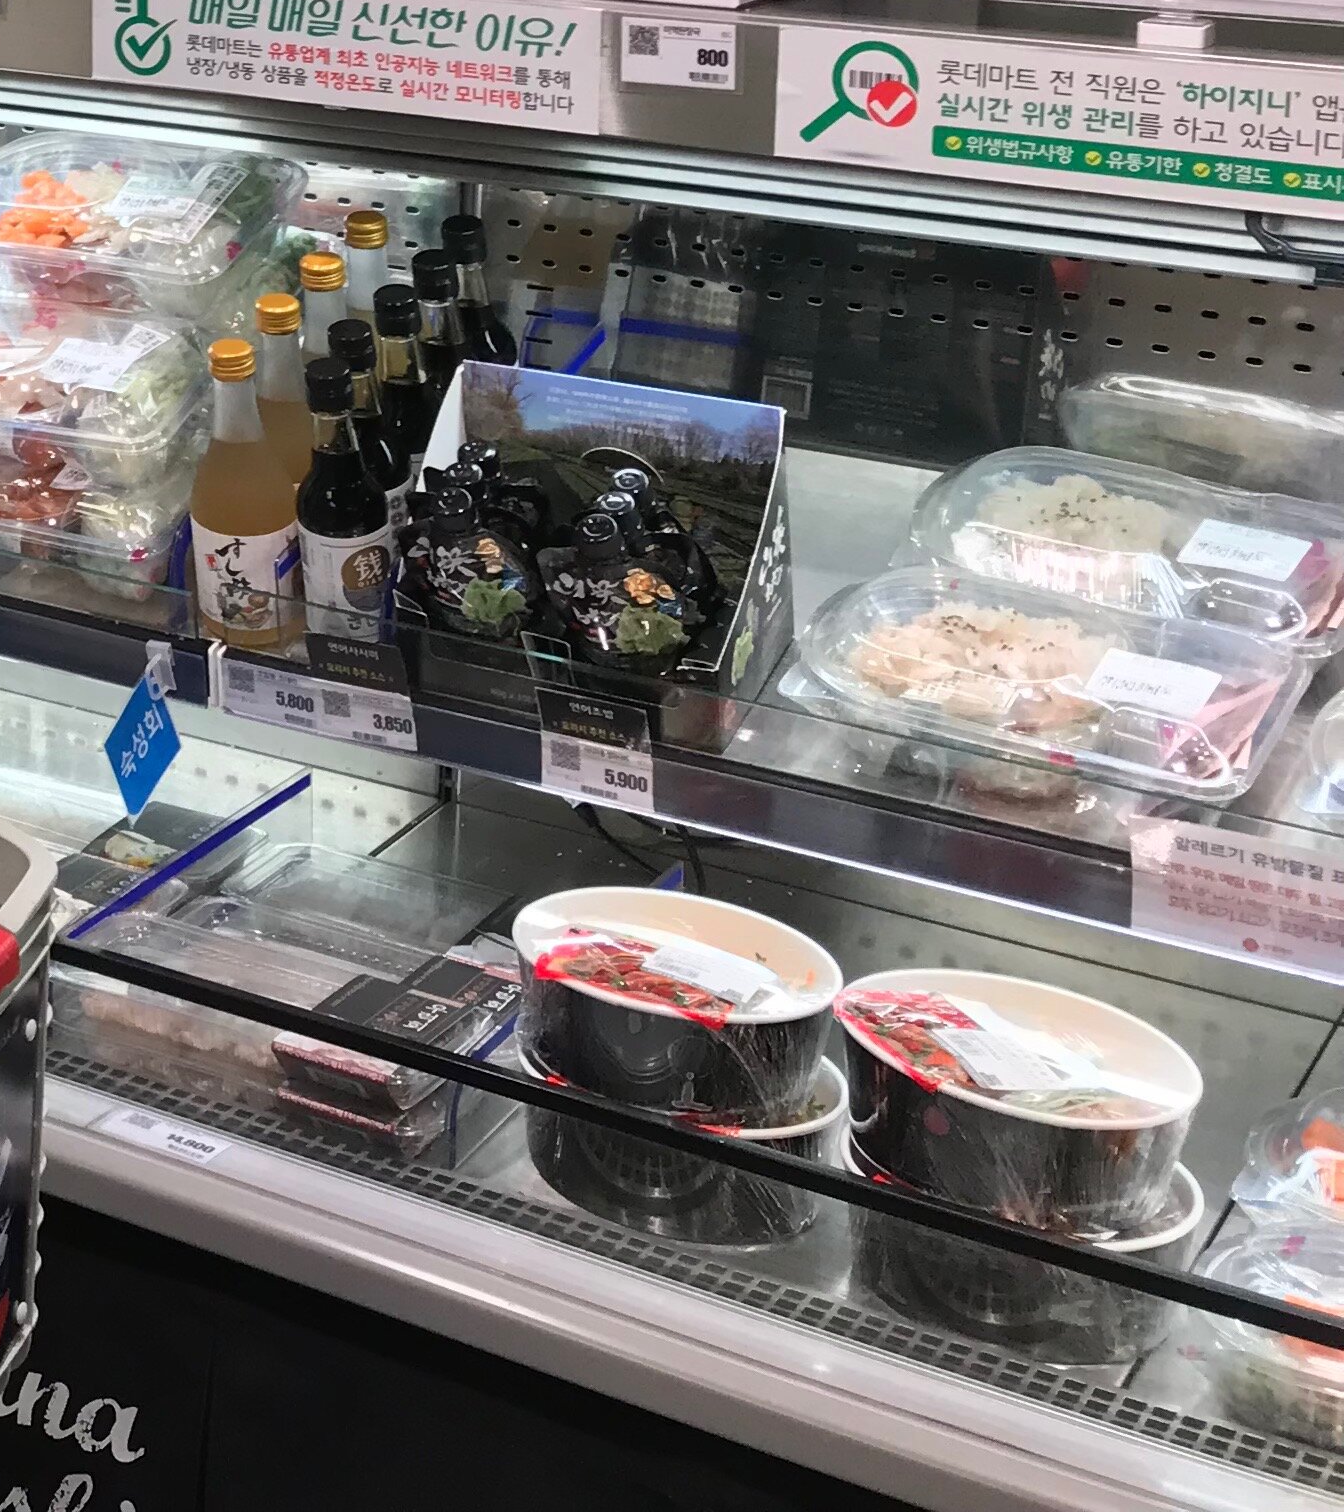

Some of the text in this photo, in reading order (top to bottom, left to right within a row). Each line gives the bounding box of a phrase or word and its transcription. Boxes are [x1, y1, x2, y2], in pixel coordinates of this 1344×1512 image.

[352, 0, 468, 48] 신선한
[477, 10, 576, 59] 이유!
[185, 33, 572, 90] 롯데마트는 유통업계 최초 인공지능 네트워크를 통해
[697, 48, 729, 67] 800
[937, 59, 1039, 93] 롯데마트
[1049, 67, 1075, 96] 전
[1085, 72, 1166, 105] 직원은
[185, 55, 574, 116] 냉장/냉동 상품을 적정온도로 실시간 모니터링합니다
[936, 90, 1011, 124] 실시간
[1020, 98, 1073, 130] 위생
[1084, 106, 1164, 141] 관리를
[1173, 114, 1228, 145] 하고
[965, 135, 1272, 187] 위생법규사항 유통기한 청결도
[275, 690, 314, 713] 5,800
[372, 713, 412, 735] 3,850
[119, 701, 164, 781] 숙성회
[604, 768, 648, 793] 5,900
[1174, 835, 1245, 864] 알레르기
